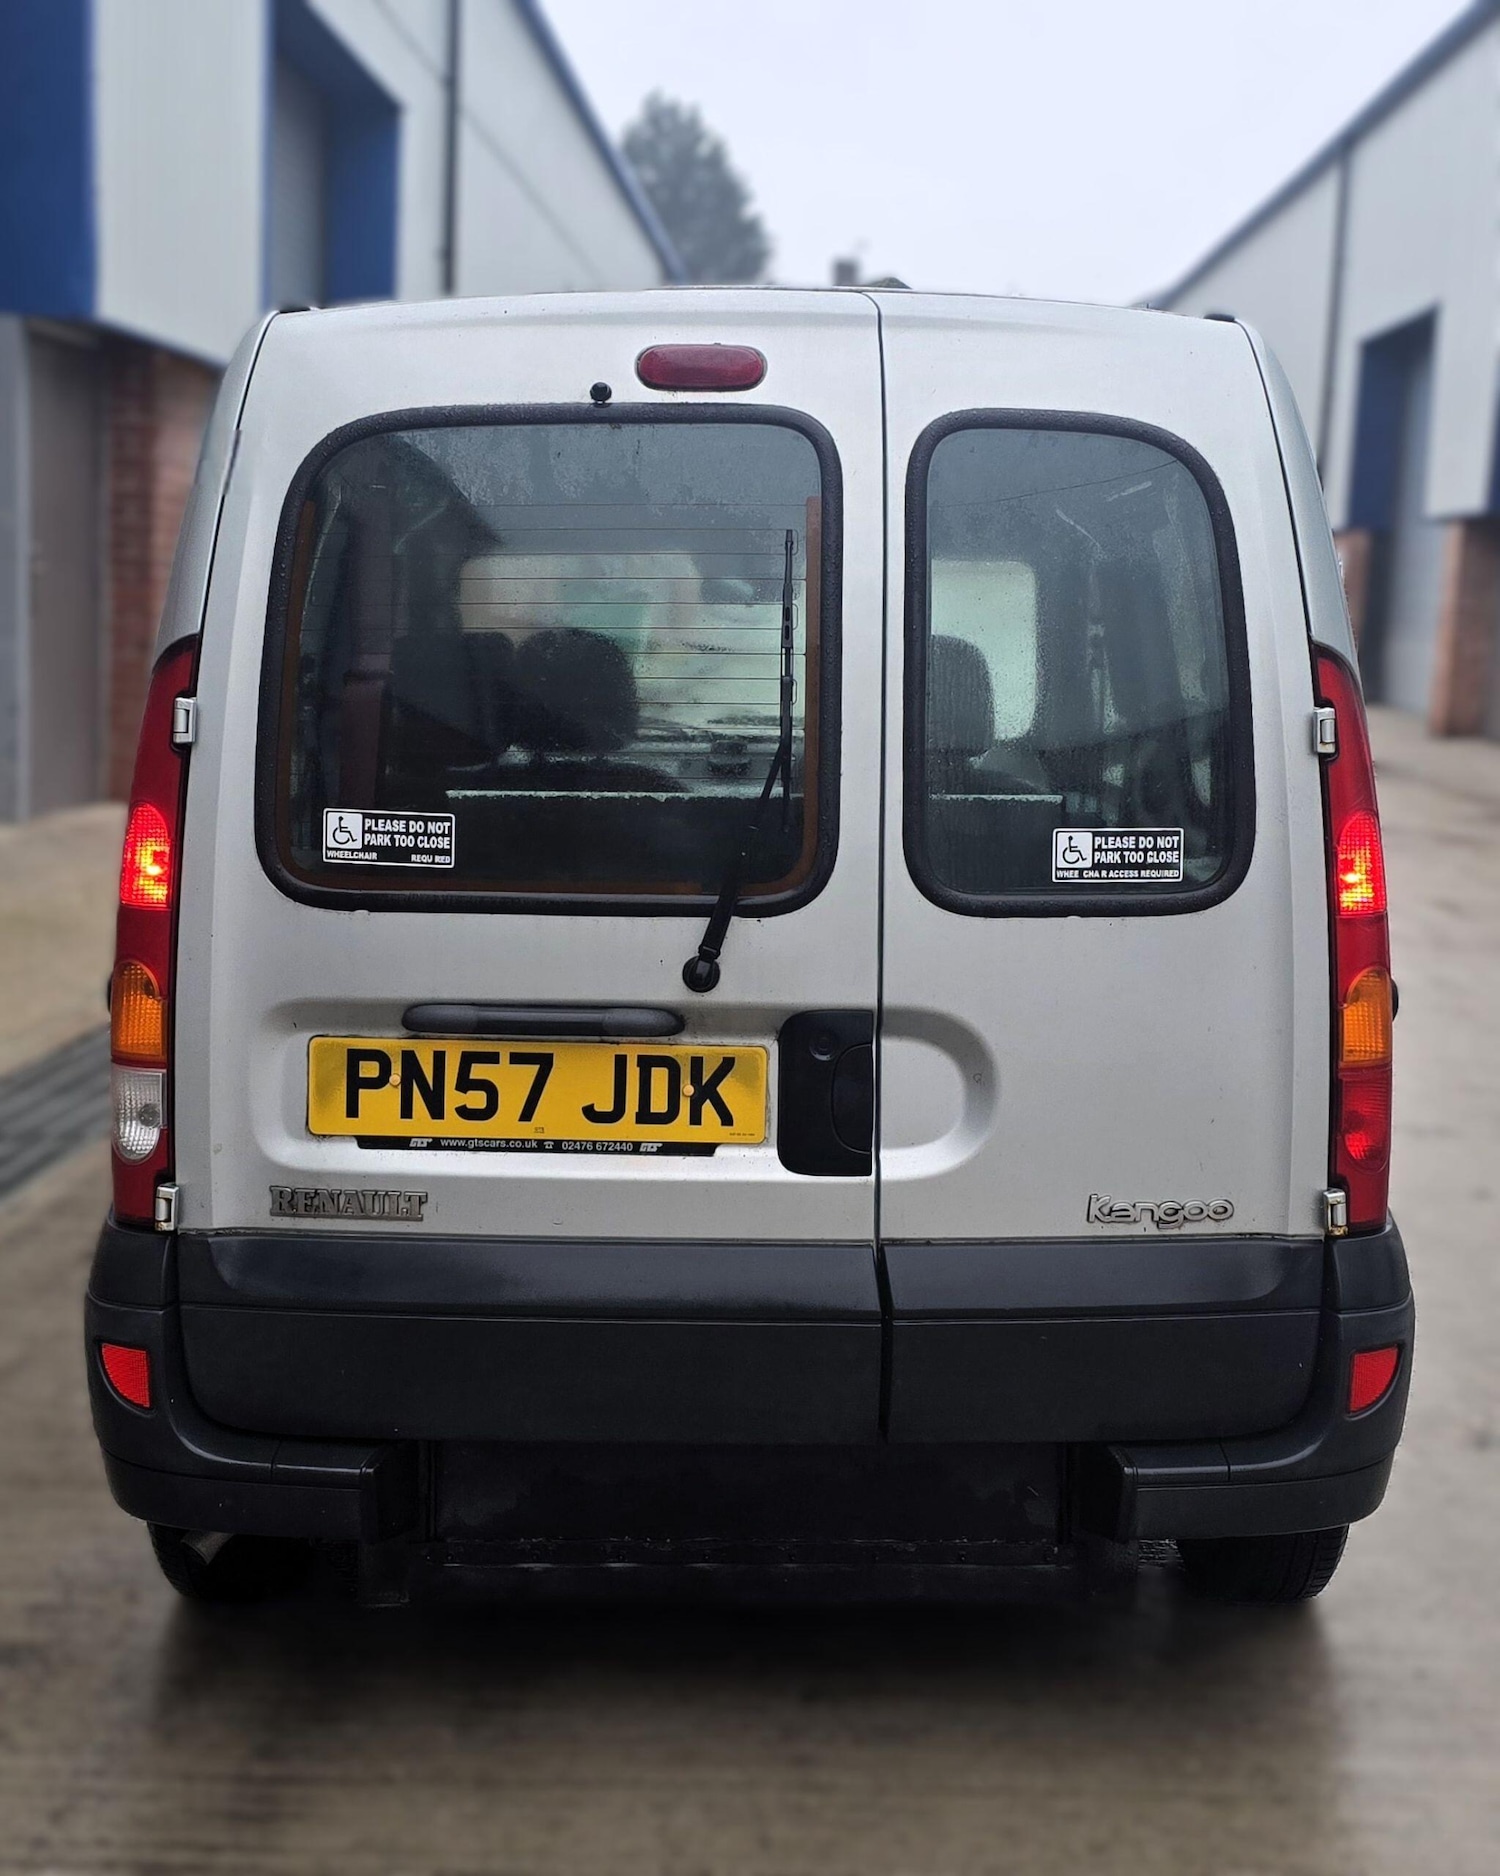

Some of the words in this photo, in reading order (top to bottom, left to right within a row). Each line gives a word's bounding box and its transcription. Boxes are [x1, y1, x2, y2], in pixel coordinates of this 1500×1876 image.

[364, 818, 406, 832] PLEASE
[409, 820, 424, 833] DO
[427, 821, 451, 834] NOT
[364, 833, 391, 846] PARK
[393, 835, 415, 847] TOO
[417, 836, 450, 849] CLOSE
[1094, 836, 1136, 849] PLEASE
[1138, 836, 1154, 849] DO
[1157, 836, 1180, 849] NOT
[326, 850, 378, 860] WHEELCHAIR
[1094, 851, 1121, 864] PARK
[1123, 851, 1144, 864] TOO
[1147, 851, 1179, 863] CLOSE
[1108, 870, 1139, 878] ACCESS
[1140, 870, 1179, 878] REQUIRED
[345, 1048, 554, 1122] PN57
[581, 1053, 736, 1127] JDK
[440, 1138, 538, 1149] www.gtscars.co.uk
[561, 1141, 593, 1151] 02476
[595, 1142, 633, 1152] 672440
[270, 1185, 428, 1222] RENAULT
[1087, 1194, 1234, 1230] Kangoo
